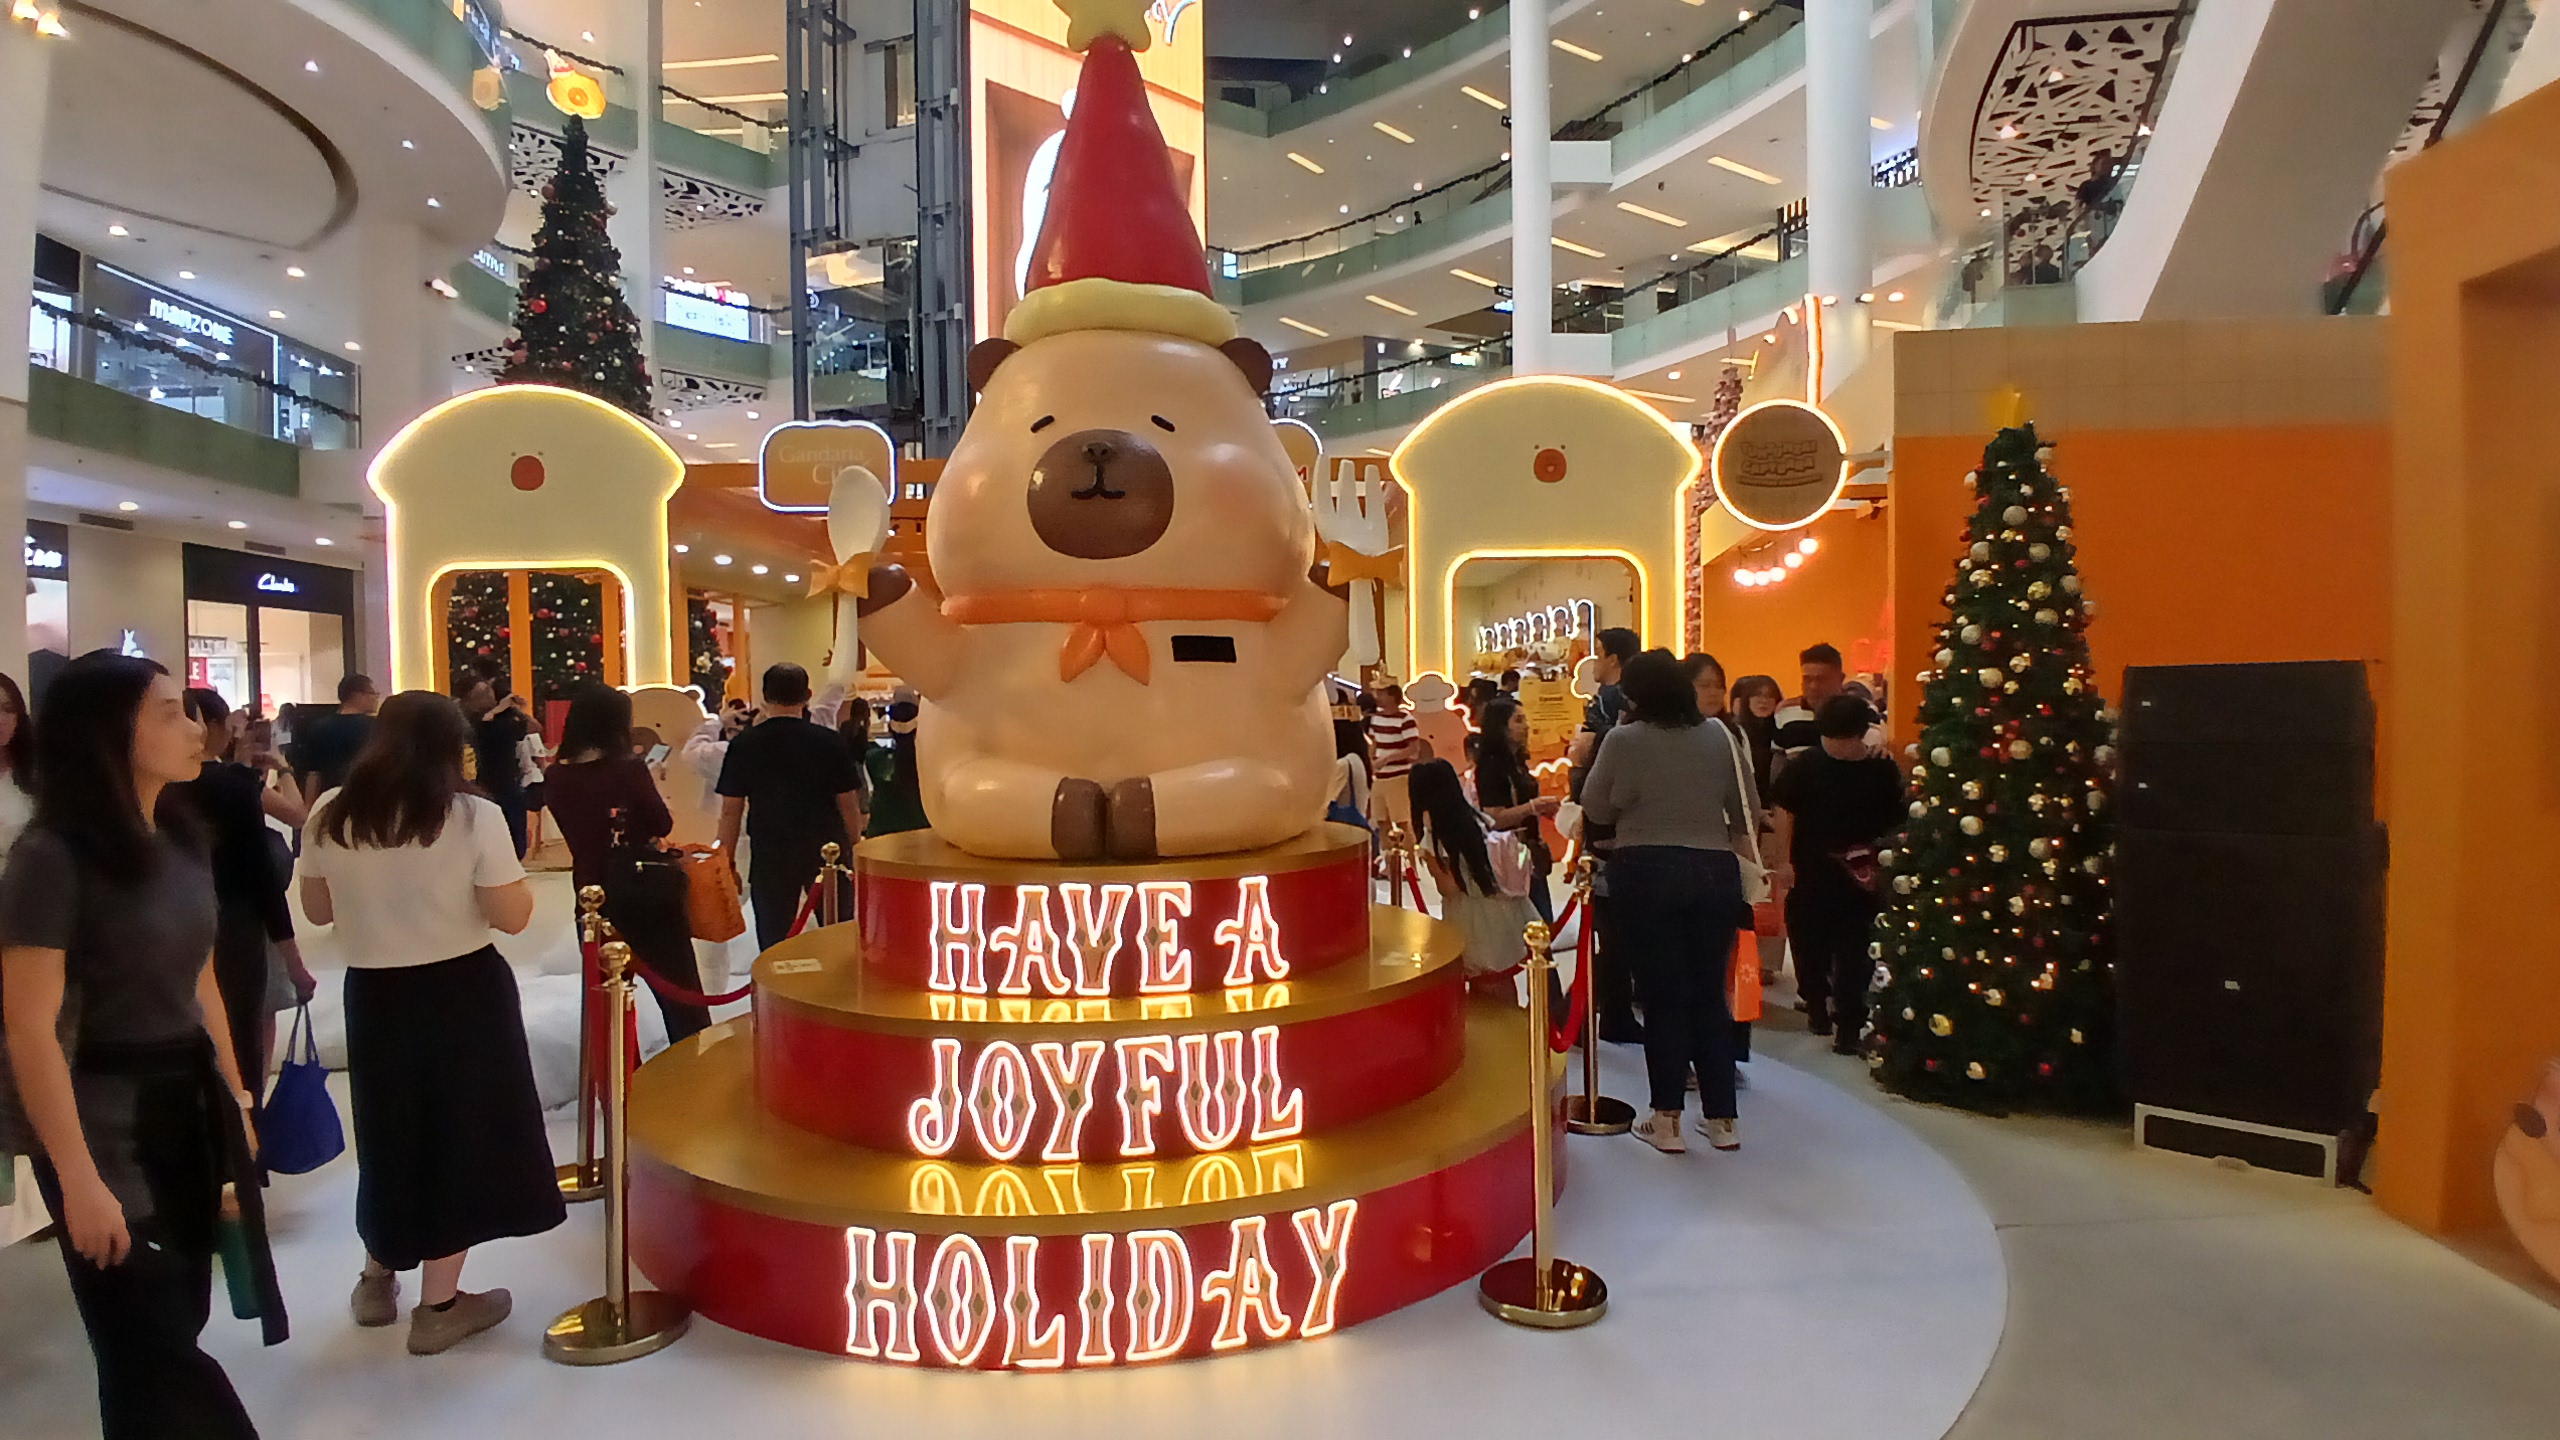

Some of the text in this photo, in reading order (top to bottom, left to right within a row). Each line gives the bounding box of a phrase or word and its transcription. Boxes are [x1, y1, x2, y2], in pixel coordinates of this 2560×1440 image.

[778, 444, 865, 463] Gandaria
[928, 874, 1291, 997] HAVE A
[906, 1024, 1304, 1163] JOYFUL
[844, 1198, 1359, 1369] HOLIDAY
